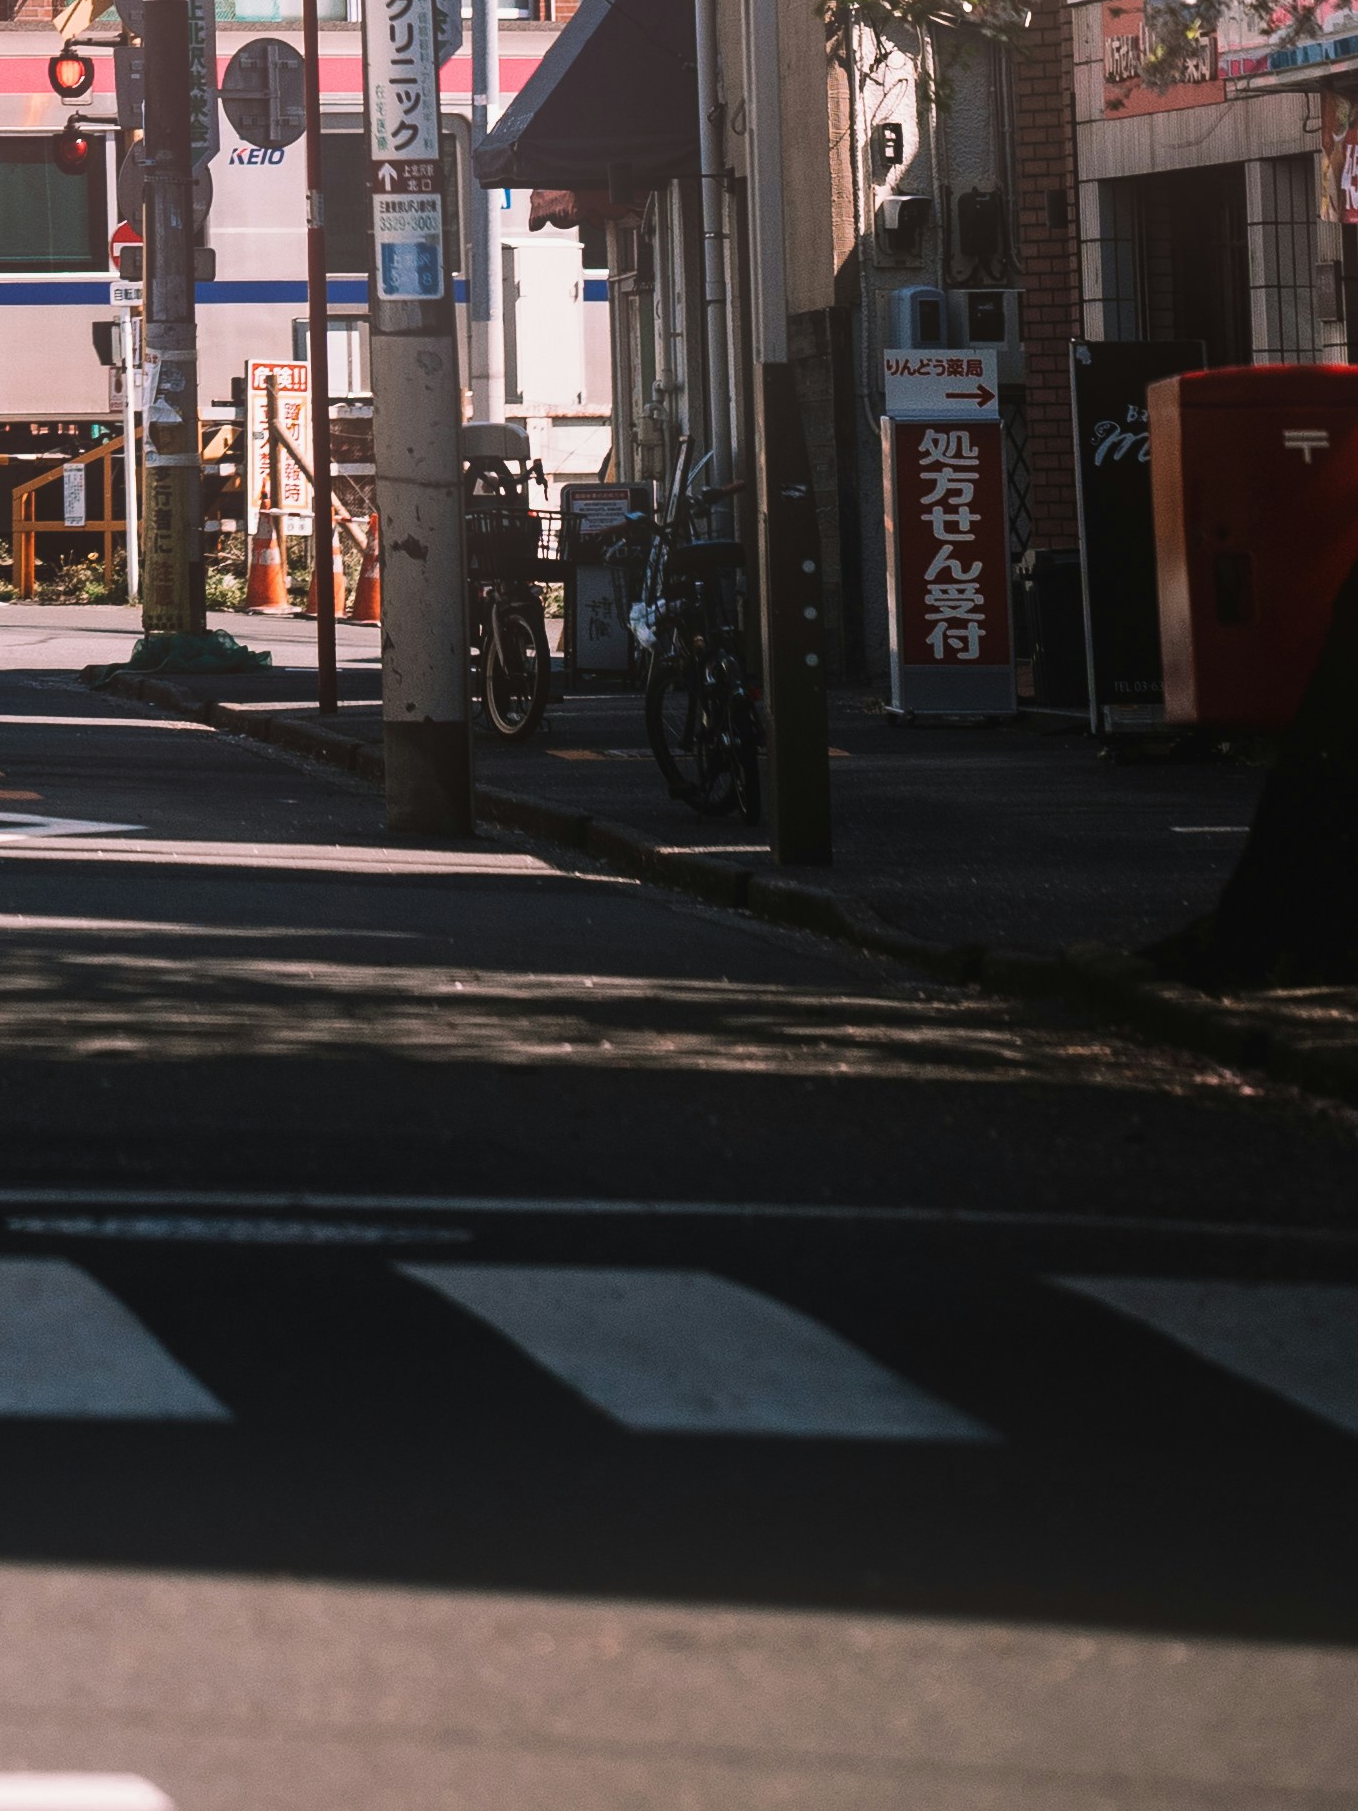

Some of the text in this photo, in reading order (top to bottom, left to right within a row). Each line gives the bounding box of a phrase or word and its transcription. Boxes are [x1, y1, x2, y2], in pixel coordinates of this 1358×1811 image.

[229, 147, 285, 165] KEIO
[886, 358, 983, 378] りんどう薬局
[918, 428, 986, 660] 処方せん受付
